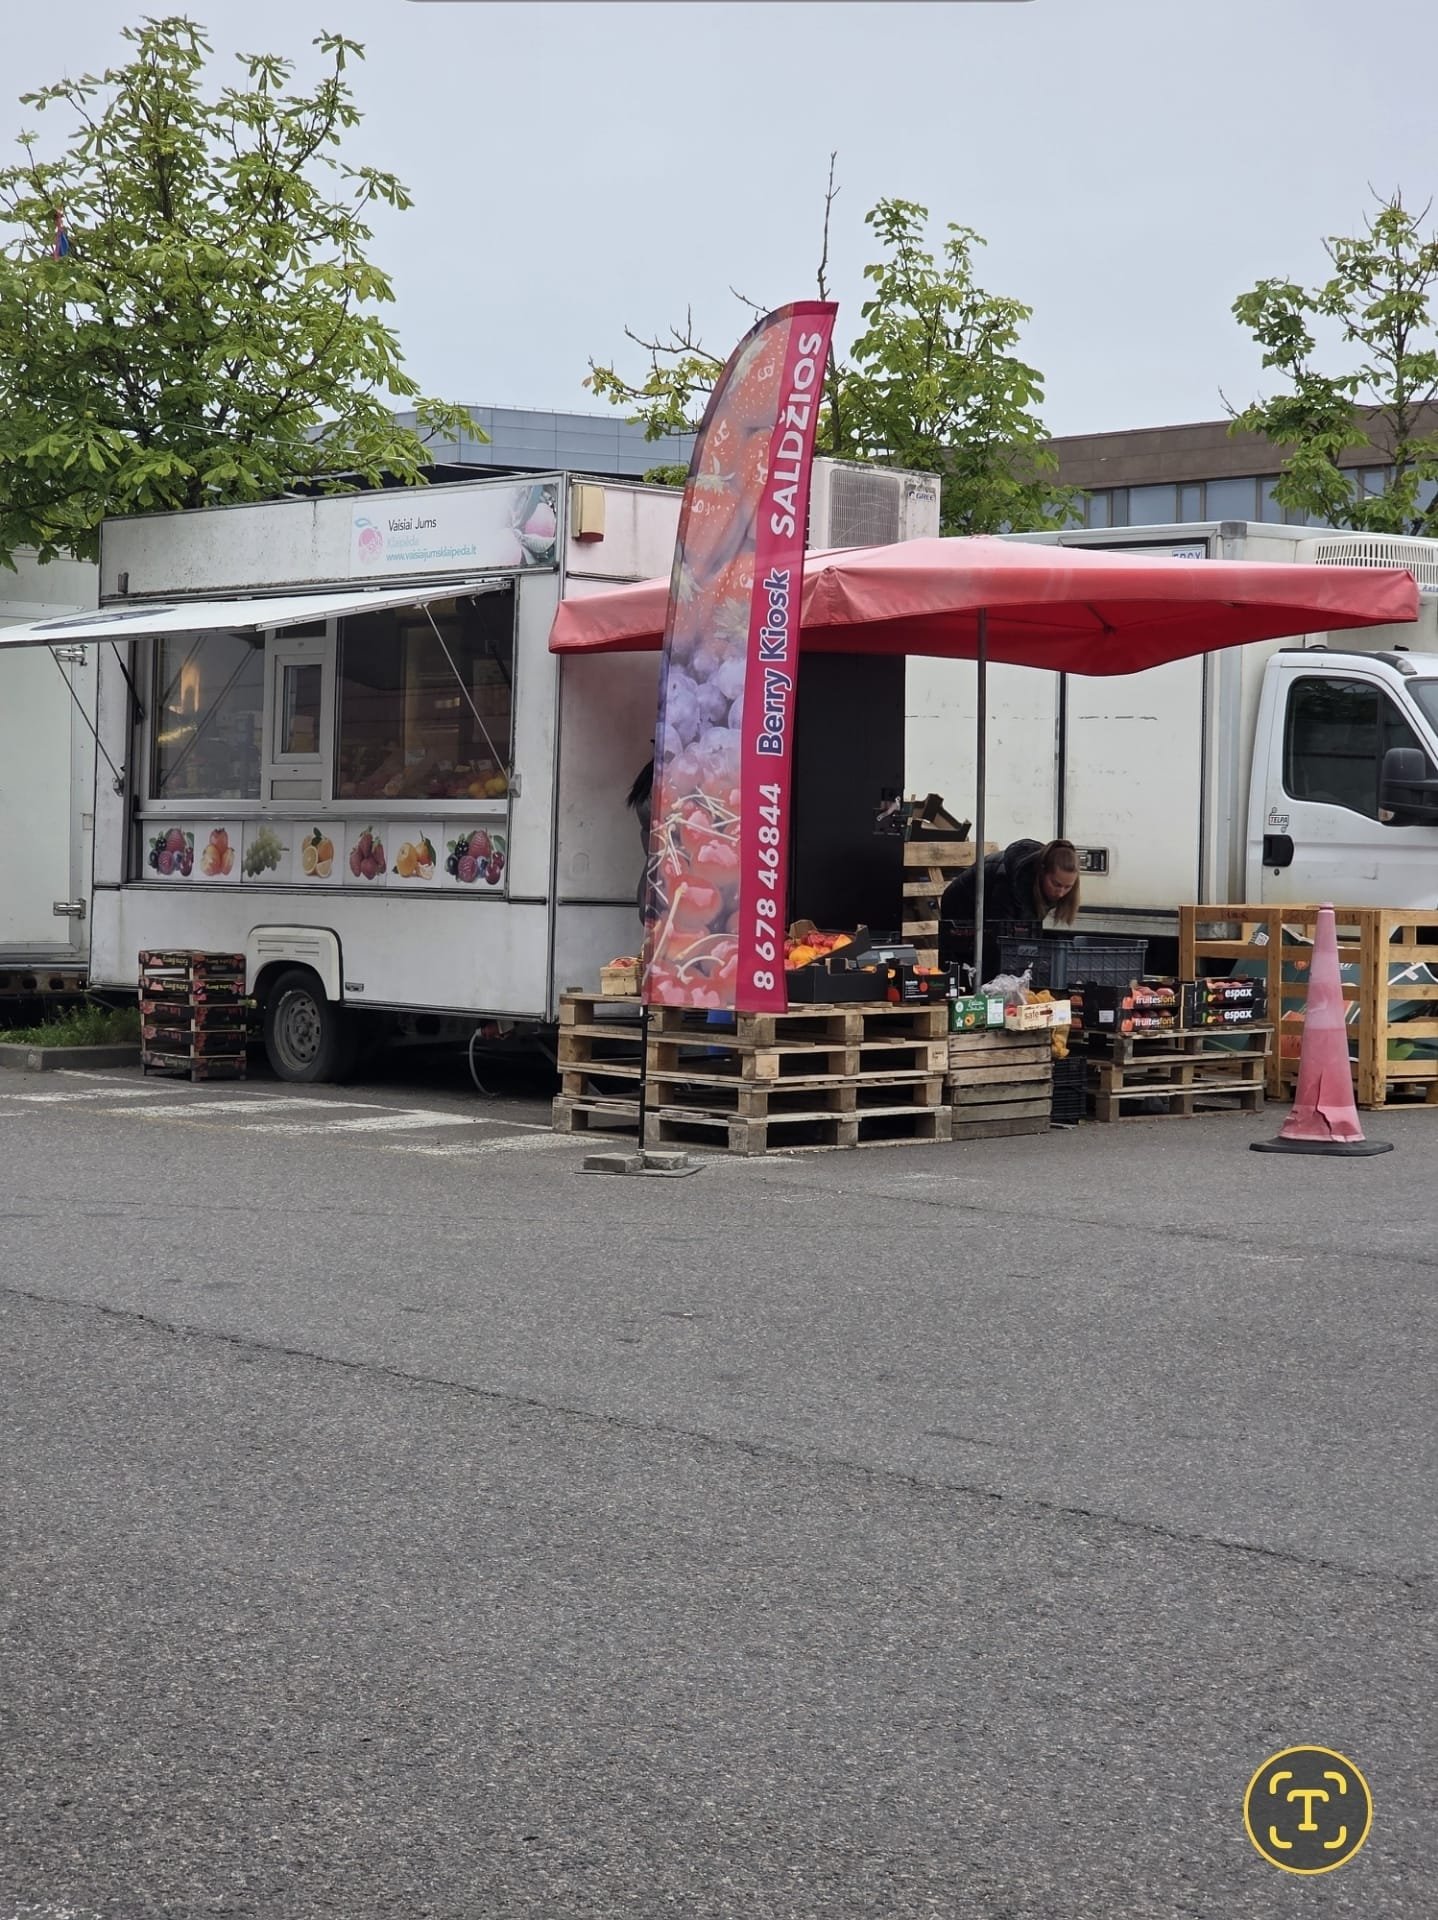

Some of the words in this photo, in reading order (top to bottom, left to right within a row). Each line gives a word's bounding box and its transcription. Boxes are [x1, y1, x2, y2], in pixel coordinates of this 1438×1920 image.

[771, 332, 822, 539] SALDŽIOS
[388, 518, 413, 532] Vaisiai
[415, 516, 437, 529] Jums
[758, 567, 790, 662] Kiosk
[756, 668, 792, 757] Berry
[1269, 816, 1288, 824] TELPA
[758, 783, 782, 890] 46844
[755, 898, 777, 962] 678
[753, 970, 775, 990] 8
[1225, 988, 1252, 1000] espax
[1024, 1010, 1040, 1020] safe
[1224, 1010, 1252, 1022] espax
